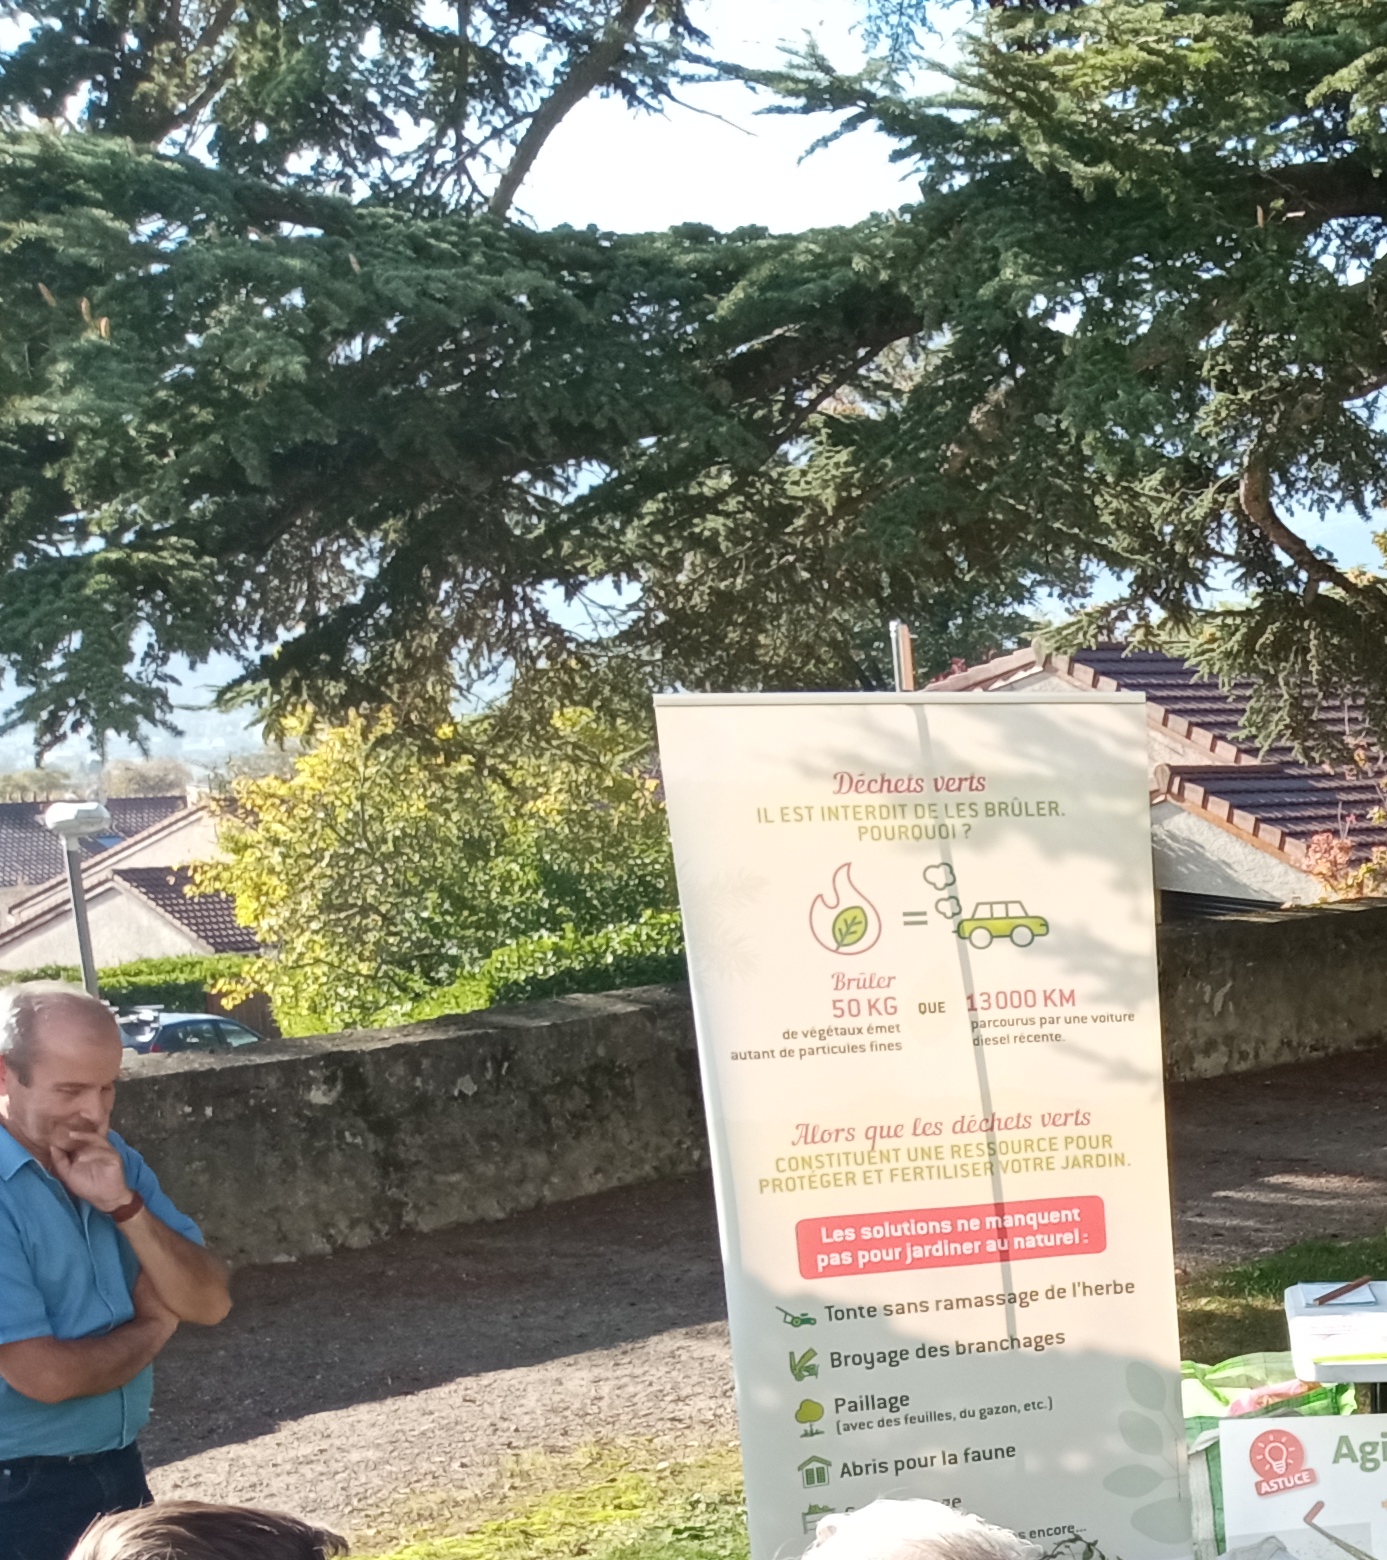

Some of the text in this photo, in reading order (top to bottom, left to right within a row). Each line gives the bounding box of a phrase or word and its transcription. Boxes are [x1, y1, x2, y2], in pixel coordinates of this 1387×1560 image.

[832, 771, 986, 795] Déchets verts
[757, 797, 1066, 824] IL EST INTERDIT DE LES BRÛLER.
[857, 823, 956, 842] POURQUOI
[830, 971, 898, 993] Brûler
[832, 995, 899, 1018] 50 KG
[918, 1001, 946, 1015] QUE
[1043, 988, 1077, 1008] KM
[782, 1022, 902, 1043] de végétaux émet
[971, 1010, 1136, 1033] parcourus par une voiture
[730, 1038, 903, 1061] autant de particules fines
[972, 1030, 1066, 1047] diesel récente.
[791, 1108, 1092, 1151] Alors que les déchets verts
[775, 1134, 1113, 1174] CONSTITUENT UNE RESSOURCE POUR
[758, 1152, 1132, 1195] PROTÉGER ET FERTILISER VOTRE JARDIN.
[821, 1207, 1082, 1244] Les solutions ne manquent
[816, 1249, 853, 1272] pas
[858, 1246, 902, 1268] pour
[905, 1238, 981, 1265] jardiner
[985, 1236, 1010, 1252] au
[825, 1279, 1136, 1322] Tonte sans ramassage de l'herbe
[830, 1332, 1066, 1371] Broyage des branchages
[834, 1393, 910, 1415] Paillage
[836, 1419, 874, 1435] (avec
[877, 1415, 901, 1429] des
[904, 1409, 957, 1425] feuilles,
[959, 1406, 976, 1420] du
[979, 1401, 1021, 1420] gazon,
[840, 1444, 1017, 1479] Abris pour la faune
[1259, 1470, 1312, 1495] ASTUCE
